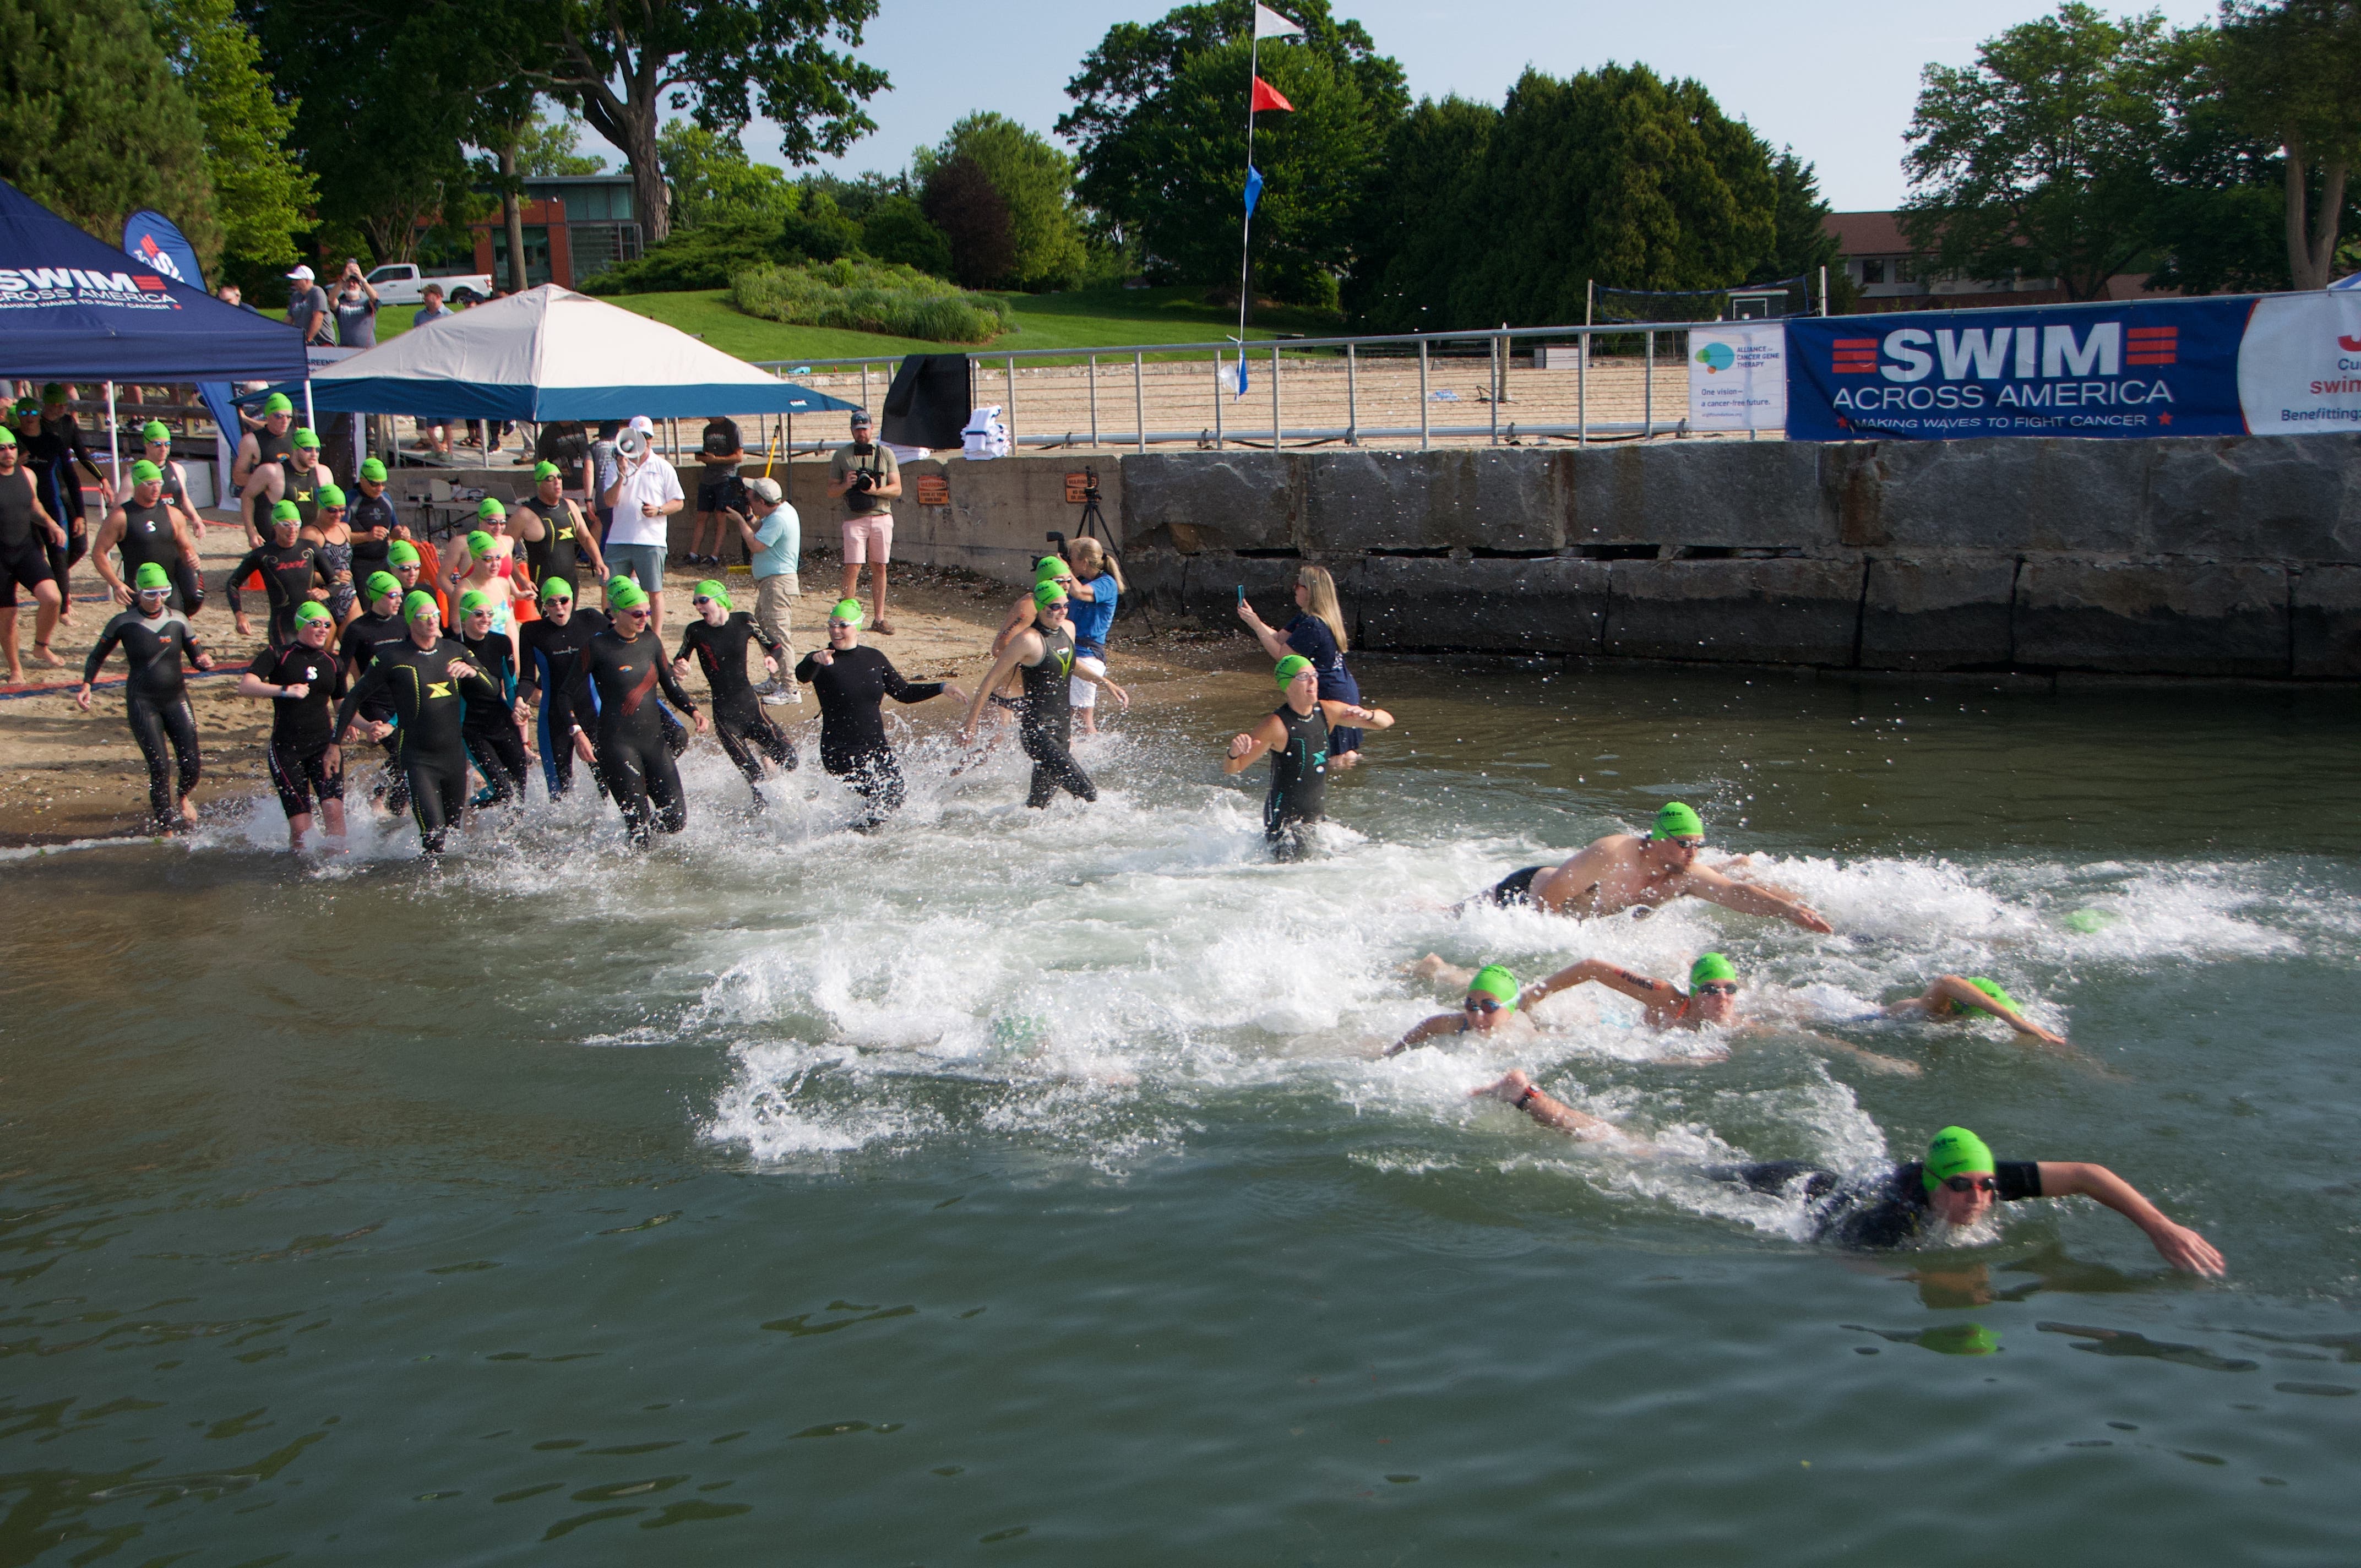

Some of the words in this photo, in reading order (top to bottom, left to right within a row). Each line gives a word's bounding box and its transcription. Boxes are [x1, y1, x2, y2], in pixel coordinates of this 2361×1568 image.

[0, 268, 140, 292] SWIM
[39, 299, 78, 308] WAVES
[79, 288, 178, 303] AMERICA
[1880, 322, 2121, 382] SWIM
[1833, 385, 1984, 410] ACROSS
[1995, 380, 2175, 407] AMERICA
[1855, 418, 1917, 428] MAKING
[1923, 417, 1981, 428] WAVES
[1987, 417, 2009, 427] TO
[2014, 417, 2065, 427] FIGHT
[2070, 415, 2147, 427] CANCER
